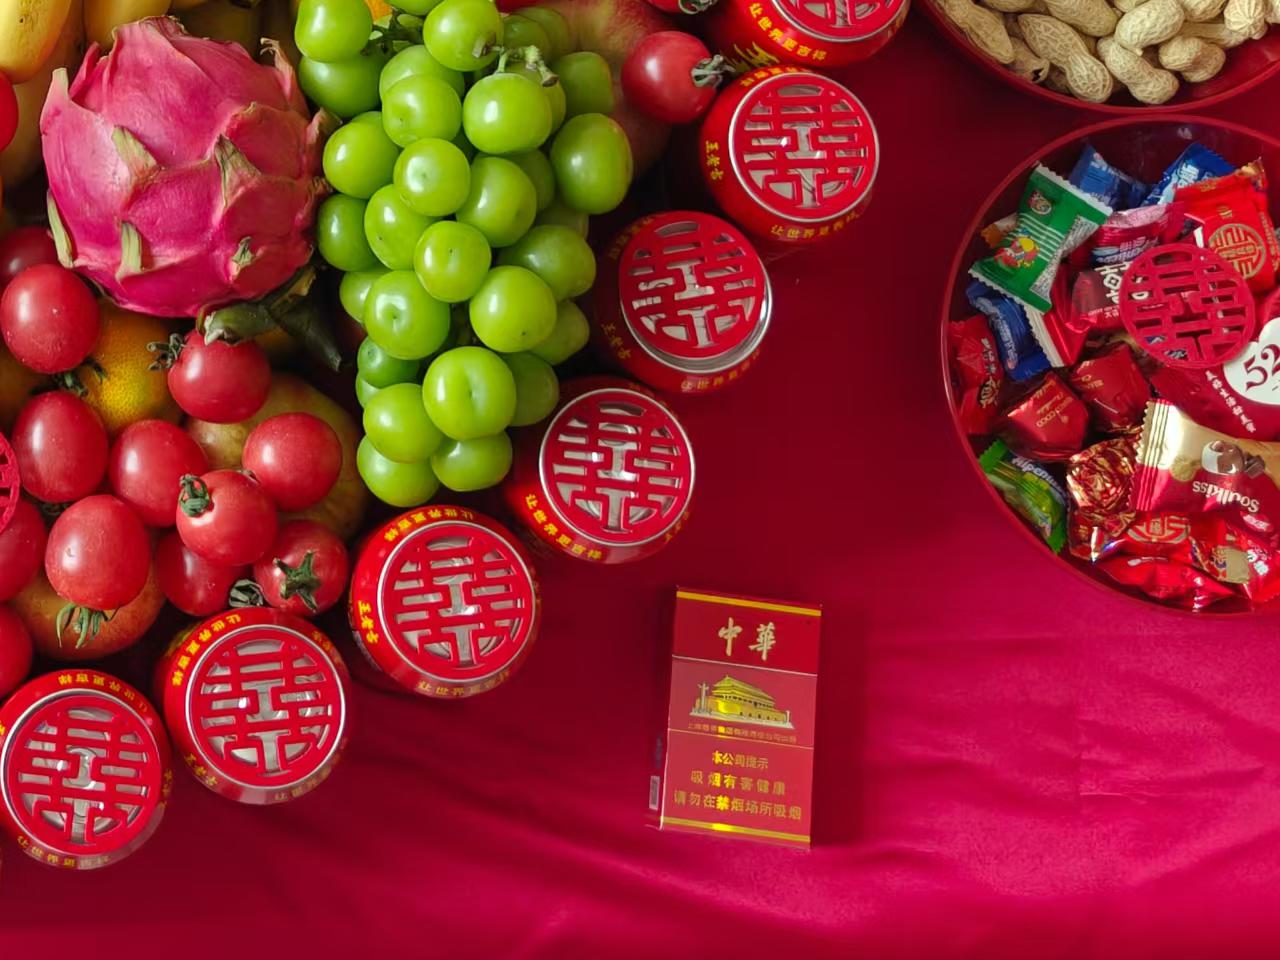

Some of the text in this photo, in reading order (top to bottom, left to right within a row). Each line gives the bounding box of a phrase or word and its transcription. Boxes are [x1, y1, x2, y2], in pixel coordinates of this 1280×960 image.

[748, 1, 826, 61] 让世界更吉祥
[704, 140, 724, 181] 王老吉
[1191, 480, 1260, 513] Soulkiss
[356, 600, 378, 644] 王老吉
[711, 749, 768, 769] 本公司提示
[689, 770, 786, 796] 吸烟有害健康
[672, 789, 802, 820] 请勿在禁烟场所吸烟
